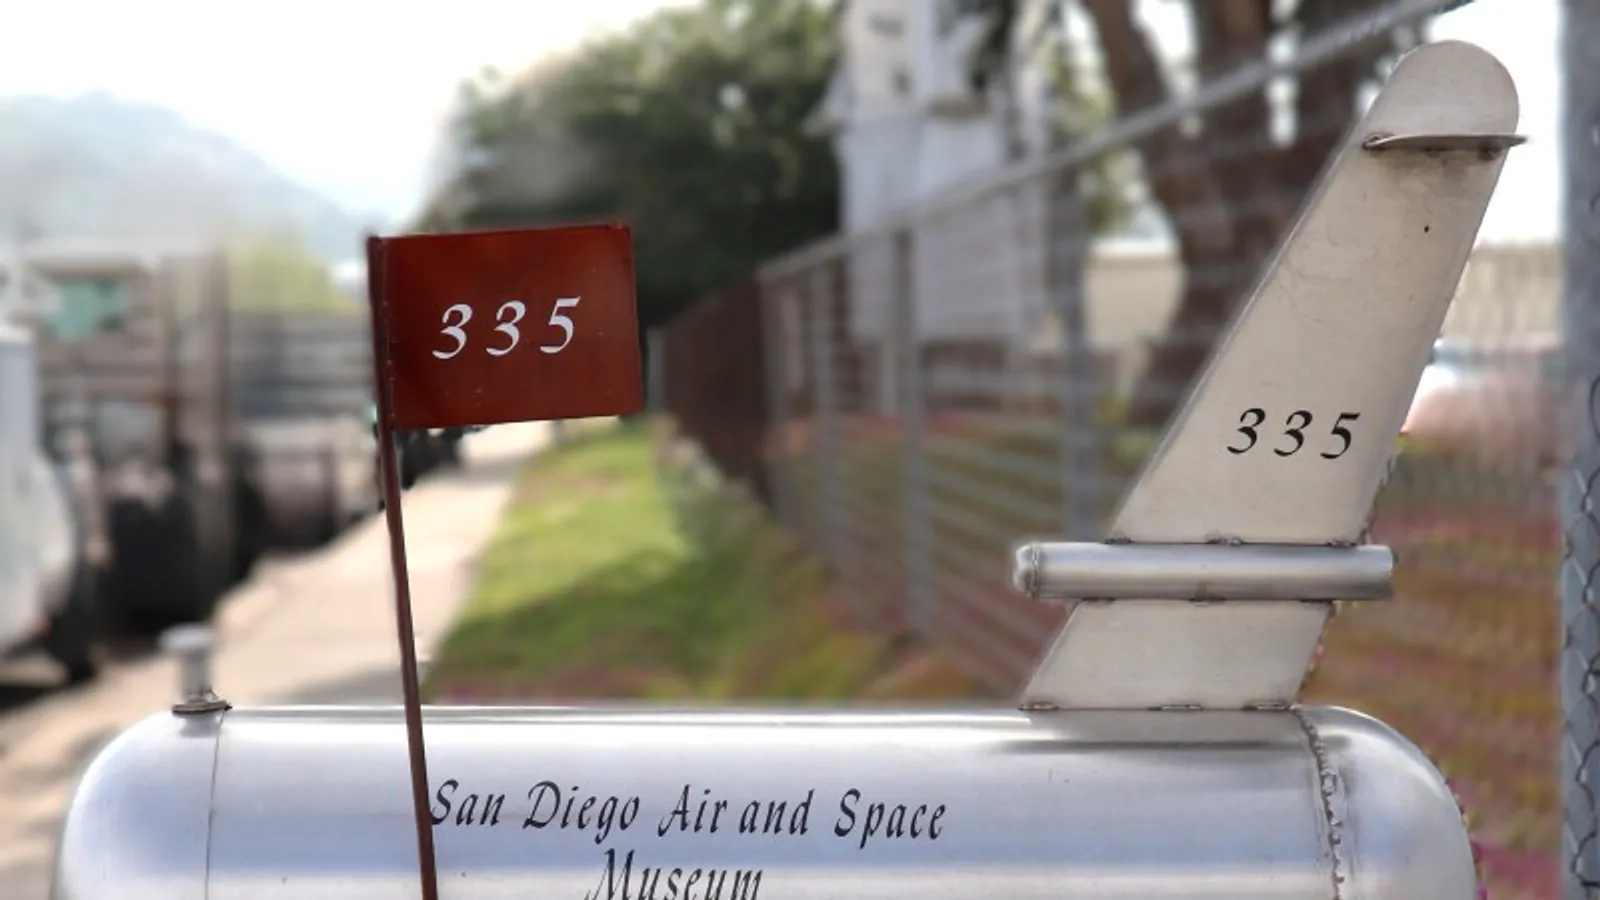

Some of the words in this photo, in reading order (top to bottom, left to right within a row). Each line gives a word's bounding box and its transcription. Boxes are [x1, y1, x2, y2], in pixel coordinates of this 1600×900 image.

[432, 296, 581, 359] 335
[1226, 408, 1361, 459] 335
[430, 779, 505, 826] San
[523, 780, 640, 844] Diego
[657, 784, 728, 837] Air
[738, 789, 815, 836] and
[833, 788, 947, 848] Space
[584, 848, 763, 900] Museum
